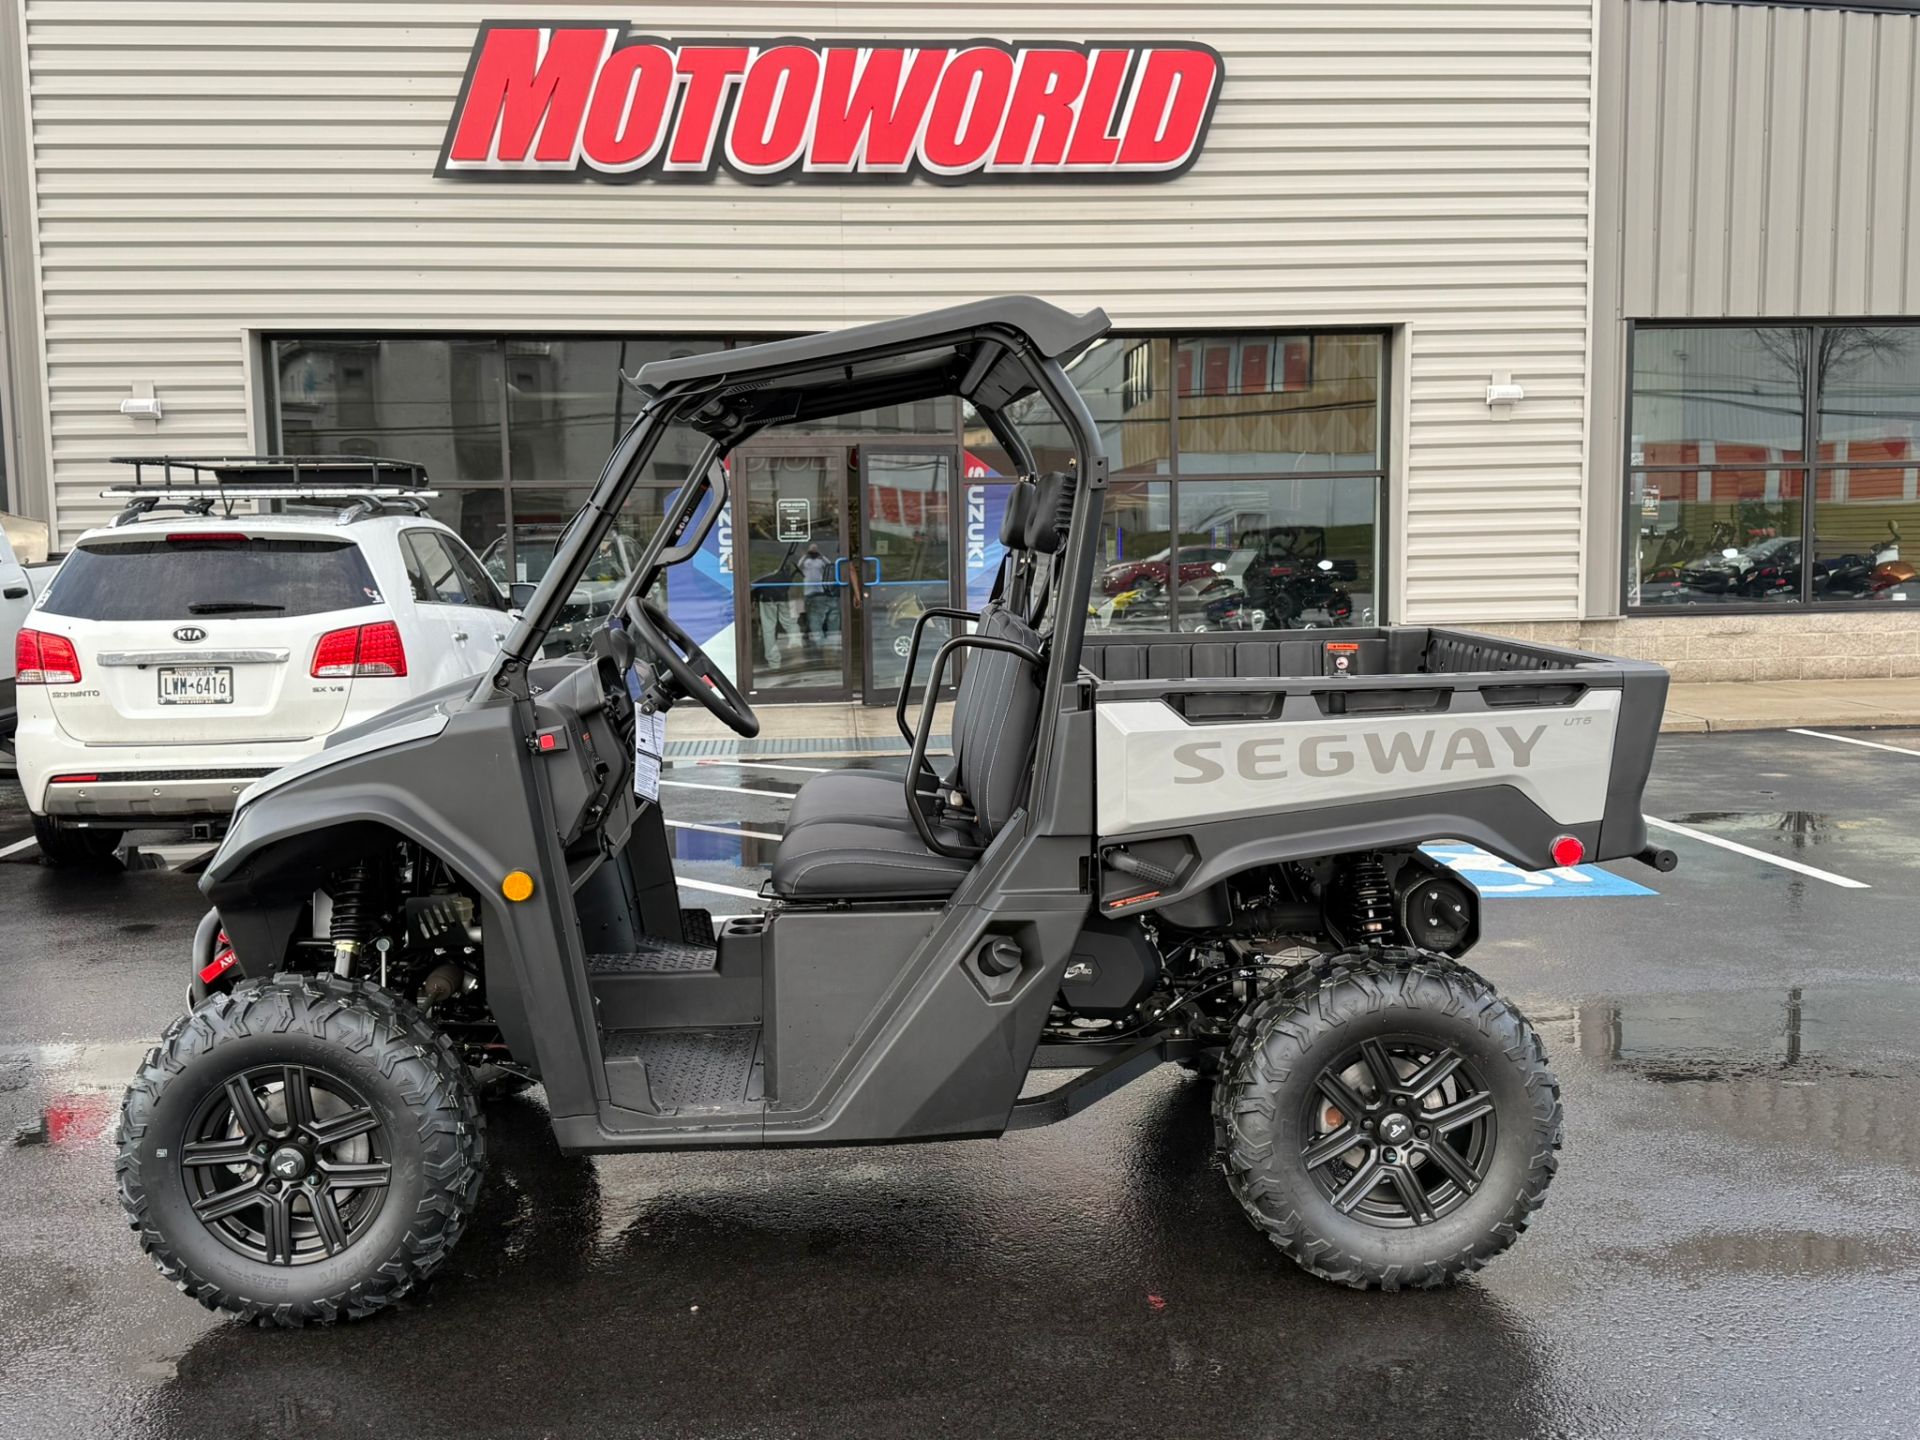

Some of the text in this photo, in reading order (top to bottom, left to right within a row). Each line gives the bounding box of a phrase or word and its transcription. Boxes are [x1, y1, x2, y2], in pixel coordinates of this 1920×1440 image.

[446, 28, 1217, 175] MOTOWORLD
[967, 466, 985, 569] SUZUKI
[177, 629, 202, 640] KIA
[1563, 716, 1593, 726] UT6
[1173, 724, 1548, 785] SEGWAY
